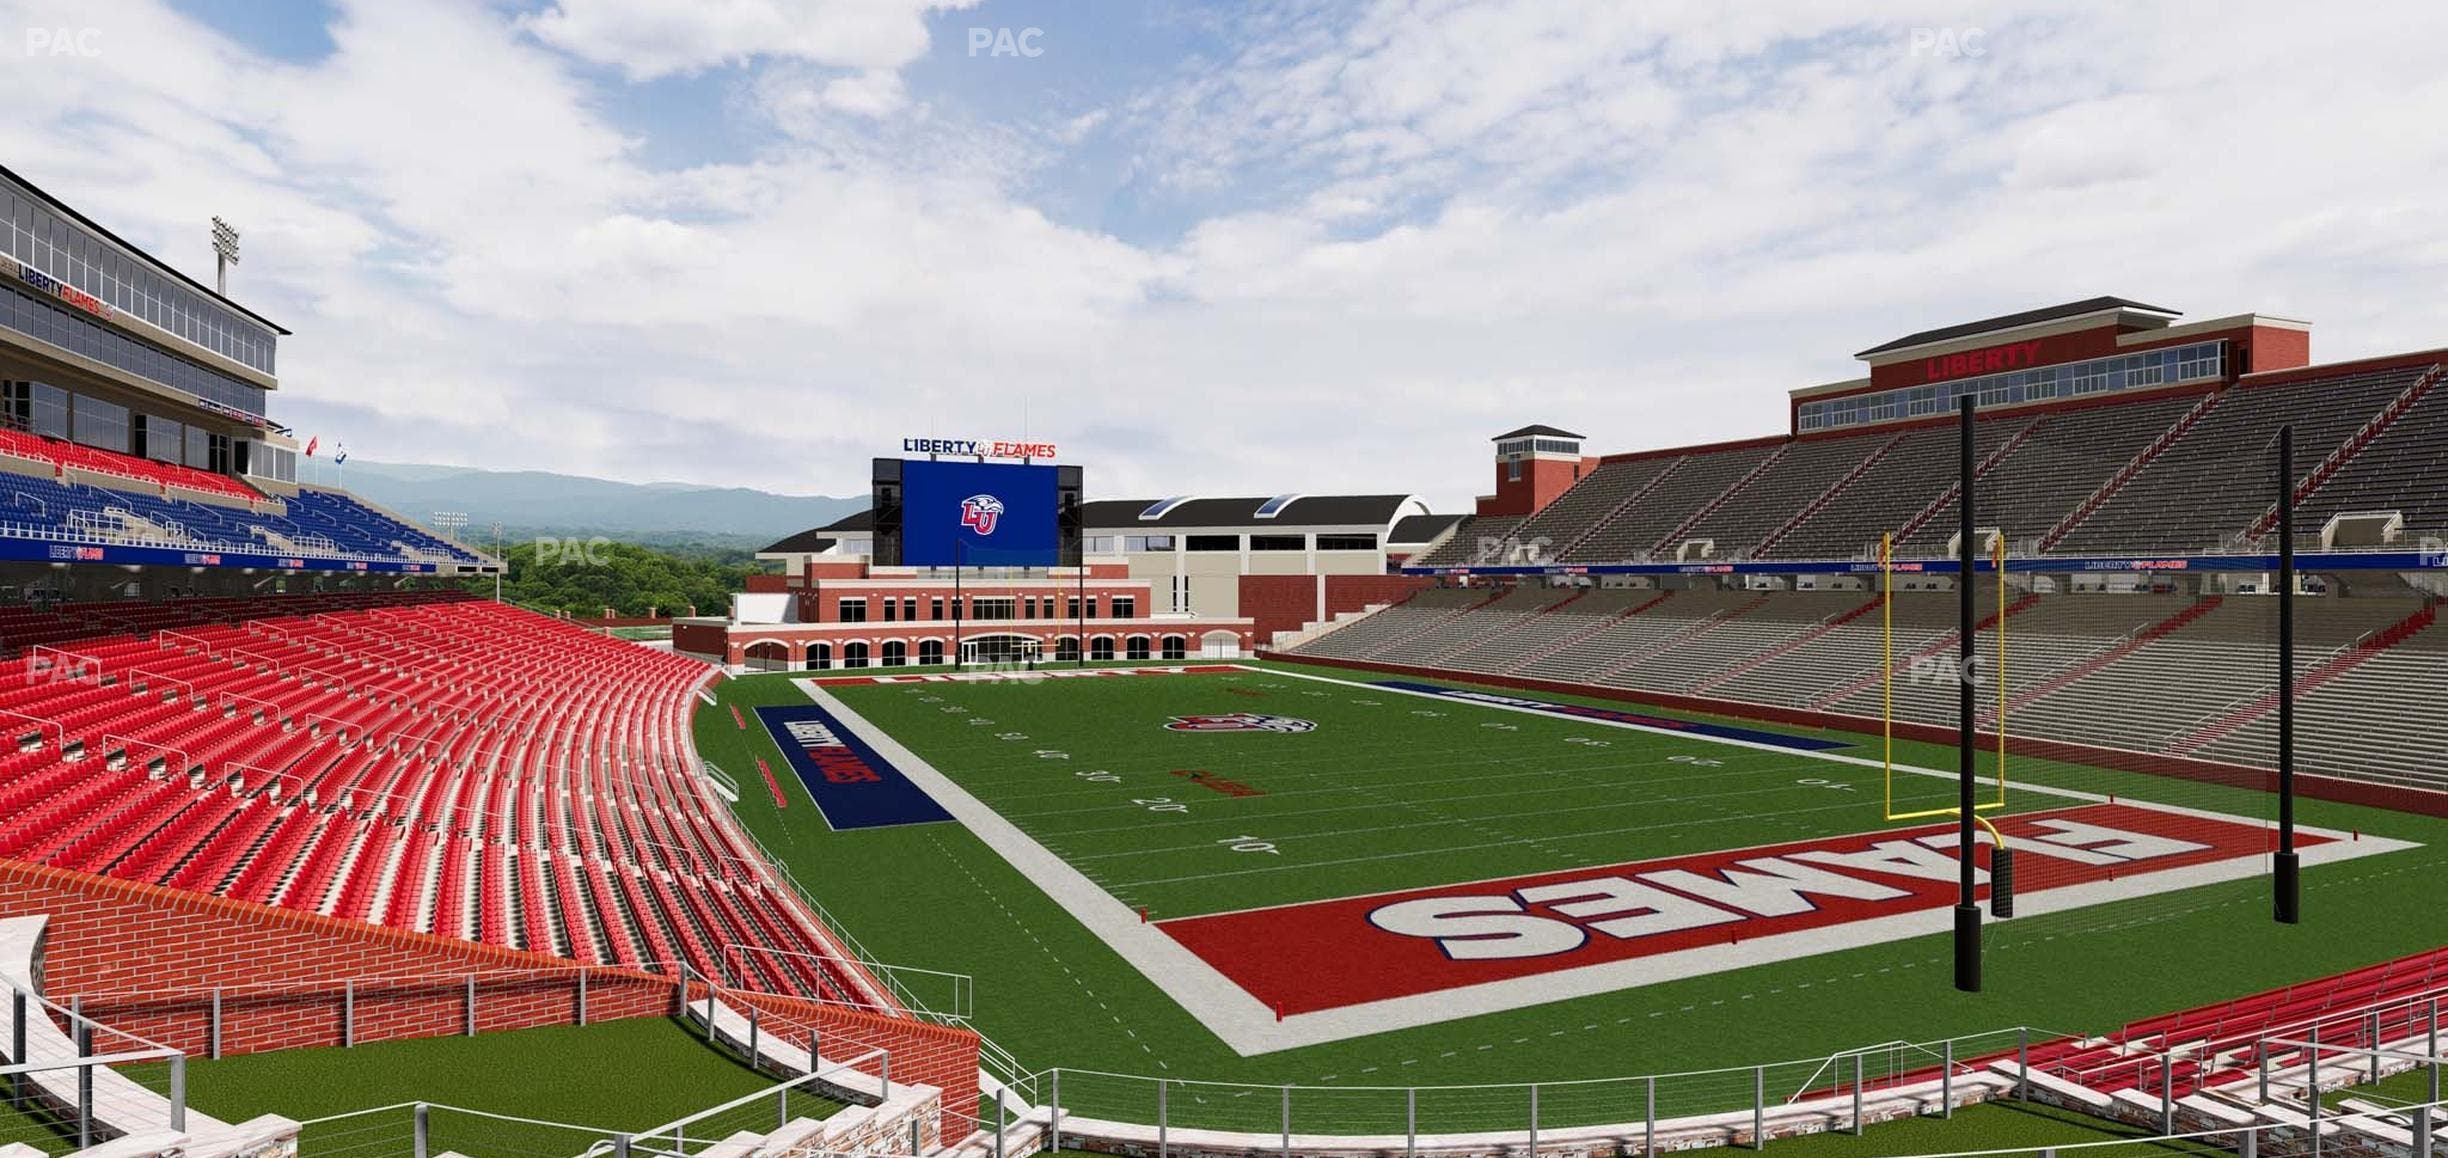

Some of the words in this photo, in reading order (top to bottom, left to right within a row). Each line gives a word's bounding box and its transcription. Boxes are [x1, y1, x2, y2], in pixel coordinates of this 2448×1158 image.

[1926, 341, 2040, 380] LIBERTY
[903, 438, 977, 454] LIBERTY
[993, 441, 1056, 458] FLAMES
[1131, 797, 1188, 813] 20
[1217, 835, 1278, 853] 10
[1369, 818, 2212, 961] FLAMES
